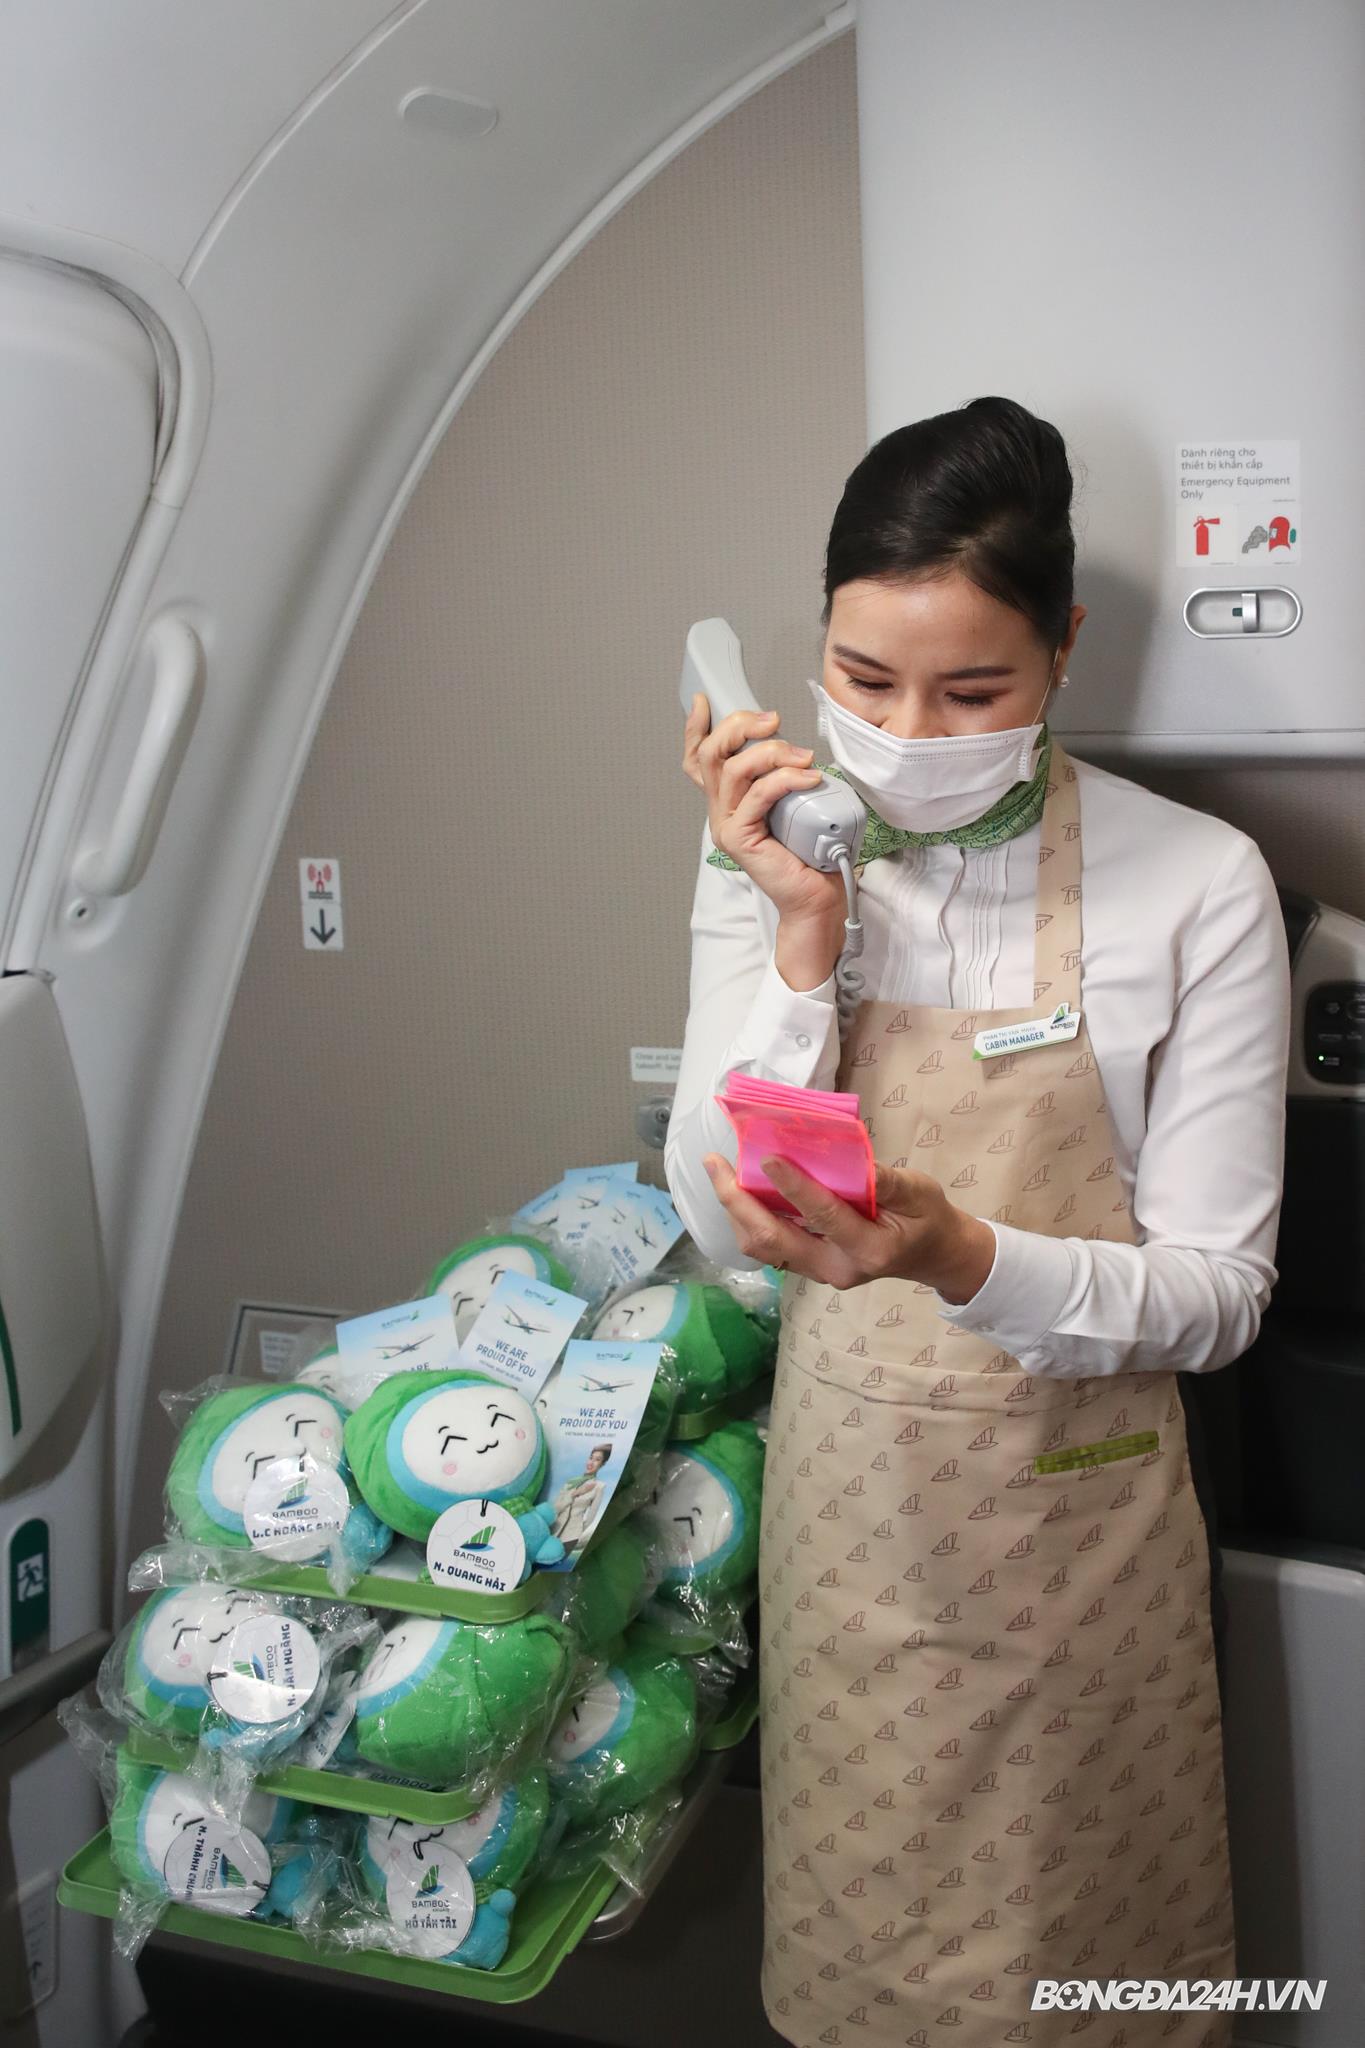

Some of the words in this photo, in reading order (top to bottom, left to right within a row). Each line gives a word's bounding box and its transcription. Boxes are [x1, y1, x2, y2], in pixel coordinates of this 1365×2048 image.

[1238, 448, 1256, 457] cho
[1181, 477, 1234, 488] Emergency
[1237, 476, 1290, 487] Equipment
[1181, 490, 1204, 500] Only
[985, 1039, 1008, 1051] CABIN
[1009, 1031, 1045, 1046] MANAGER
[495, 1339, 510, 1351] WE
[510, 1347, 528, 1361] ARE
[476, 1344, 506, 1363] PROUD
[505, 1358, 519, 1369] OF
[519, 1362, 537, 1378] YOU
[580, 1408, 595, 1417] WE
[595, 1409, 616, 1418] ARE
[560, 1418, 593, 1428] PROUD
[593, 1419, 608, 1428] OF
[608, 1420, 628, 1429] YOU
[273, 1508, 318, 1519] BAMBOO
[453, 1549, 496, 1568] BAMBOO
[434, 1561, 445, 1573] N.
[447, 1565, 483, 1584] QUANG
[265, 1645, 275, 1685] AMBOO
[198, 1826, 207, 1836] N.
[206, 1847, 221, 1891] BAMBOO
[411, 1899, 449, 1908] BAMBOO
